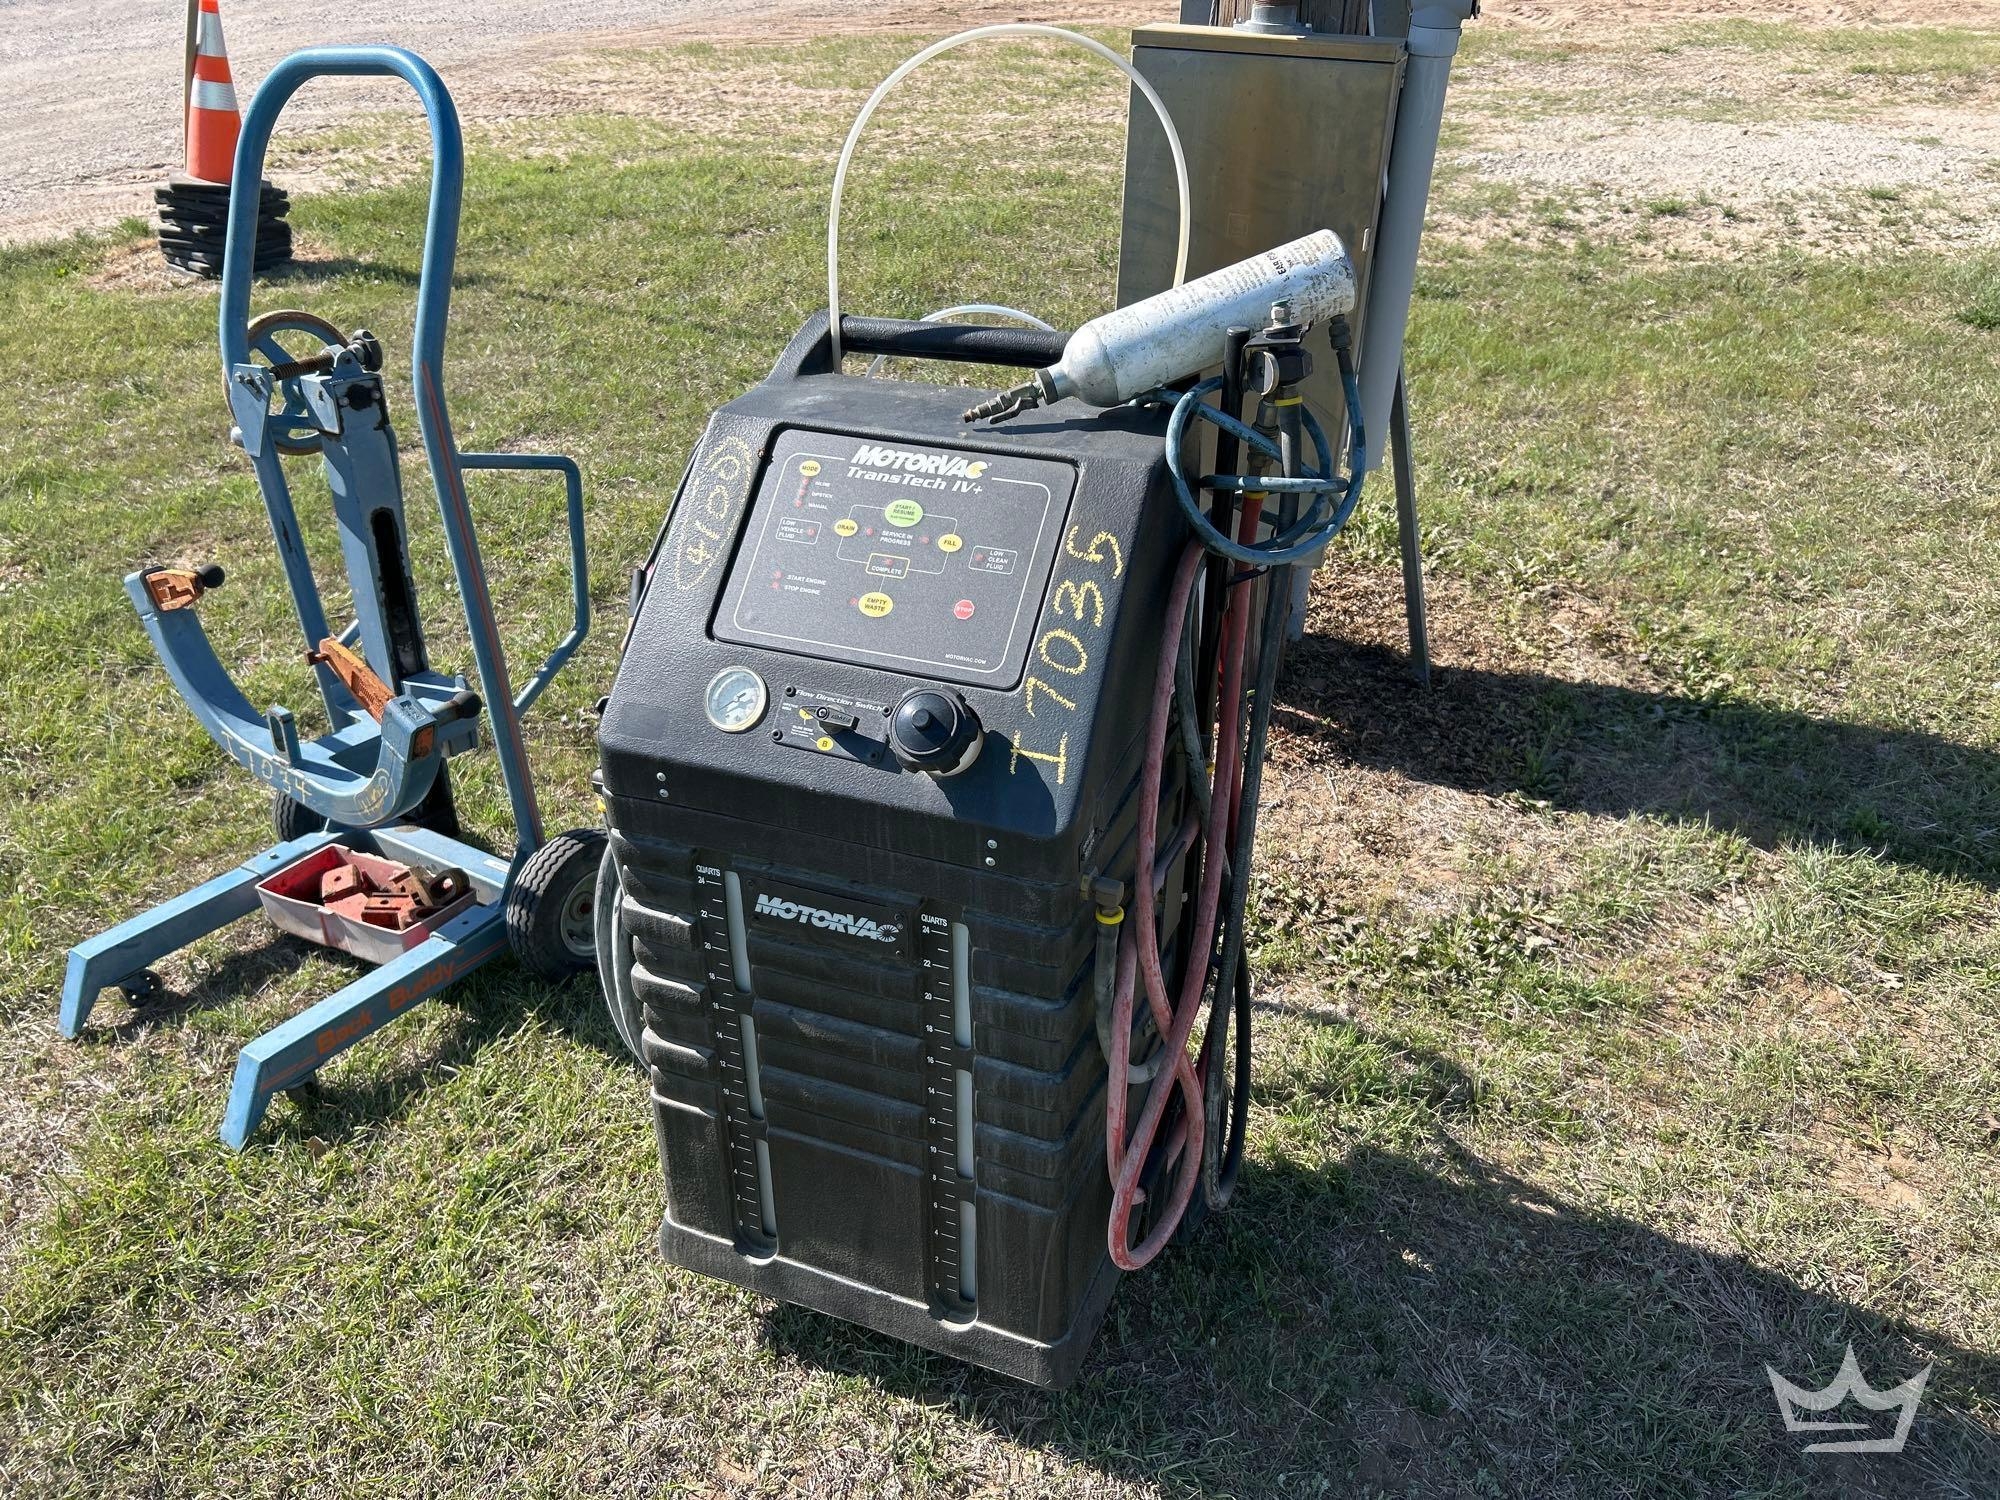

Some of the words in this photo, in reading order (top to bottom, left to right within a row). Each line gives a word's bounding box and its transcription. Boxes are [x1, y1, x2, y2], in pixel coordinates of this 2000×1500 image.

[850, 444, 988, 479] MOTORVAC
[801, 464, 818, 473] MODE
[847, 466, 947, 490] TransTech
[951, 480, 983, 495] IV+
[893, 508, 915, 517] RESUME
[780, 525, 804, 535] VEHICLE
[837, 523, 856, 532] DRAIN
[778, 532, 795, 540] FLUID
[881, 530, 906, 540] SERVICE
[880, 536, 911, 547] PROGRESS
[943, 539, 957, 547] FILL
[989, 550, 1005, 558] LOW
[871, 565, 902, 575] COMPLETE
[986, 562, 1004, 571] FLUID
[786, 574, 806, 582] START
[806, 577, 827, 586] ENGINE
[784, 584, 799, 592] STOP
[799, 586, 821, 596] ENGINE
[866, 597, 888, 606] EMPTY
[864, 603, 886, 612] WASTE
[945, 653, 987, 665] MOTORVAC.COM
[796, 689, 815, 699] Flow
[816, 693, 853, 706] Direction
[855, 701, 883, 712] Switch
[822, 740, 829, 748] B
[696, 864, 720, 877] QUARTS
[698, 876, 705, 885] 24
[701, 909, 708, 918] 22
[754, 893, 899, 943] MOTORVAC
[921, 913, 948, 927] QUARTS
[922, 925, 930, 934] 24
[704, 942, 711, 950] 20
[923, 959, 931, 968] 22
[709, 972, 716, 980] 18
[924, 992, 932, 1001] 20
[316, 1010, 373, 1055] Back
[388, 961, 456, 1011] Buddy
[712, 1002, 719, 1010] 16
[926, 1024, 933, 1033] 18
[716, 1031, 723, 1039] 14
[720, 1060, 727, 1068] 12
[927, 1056, 934, 1064] 16
